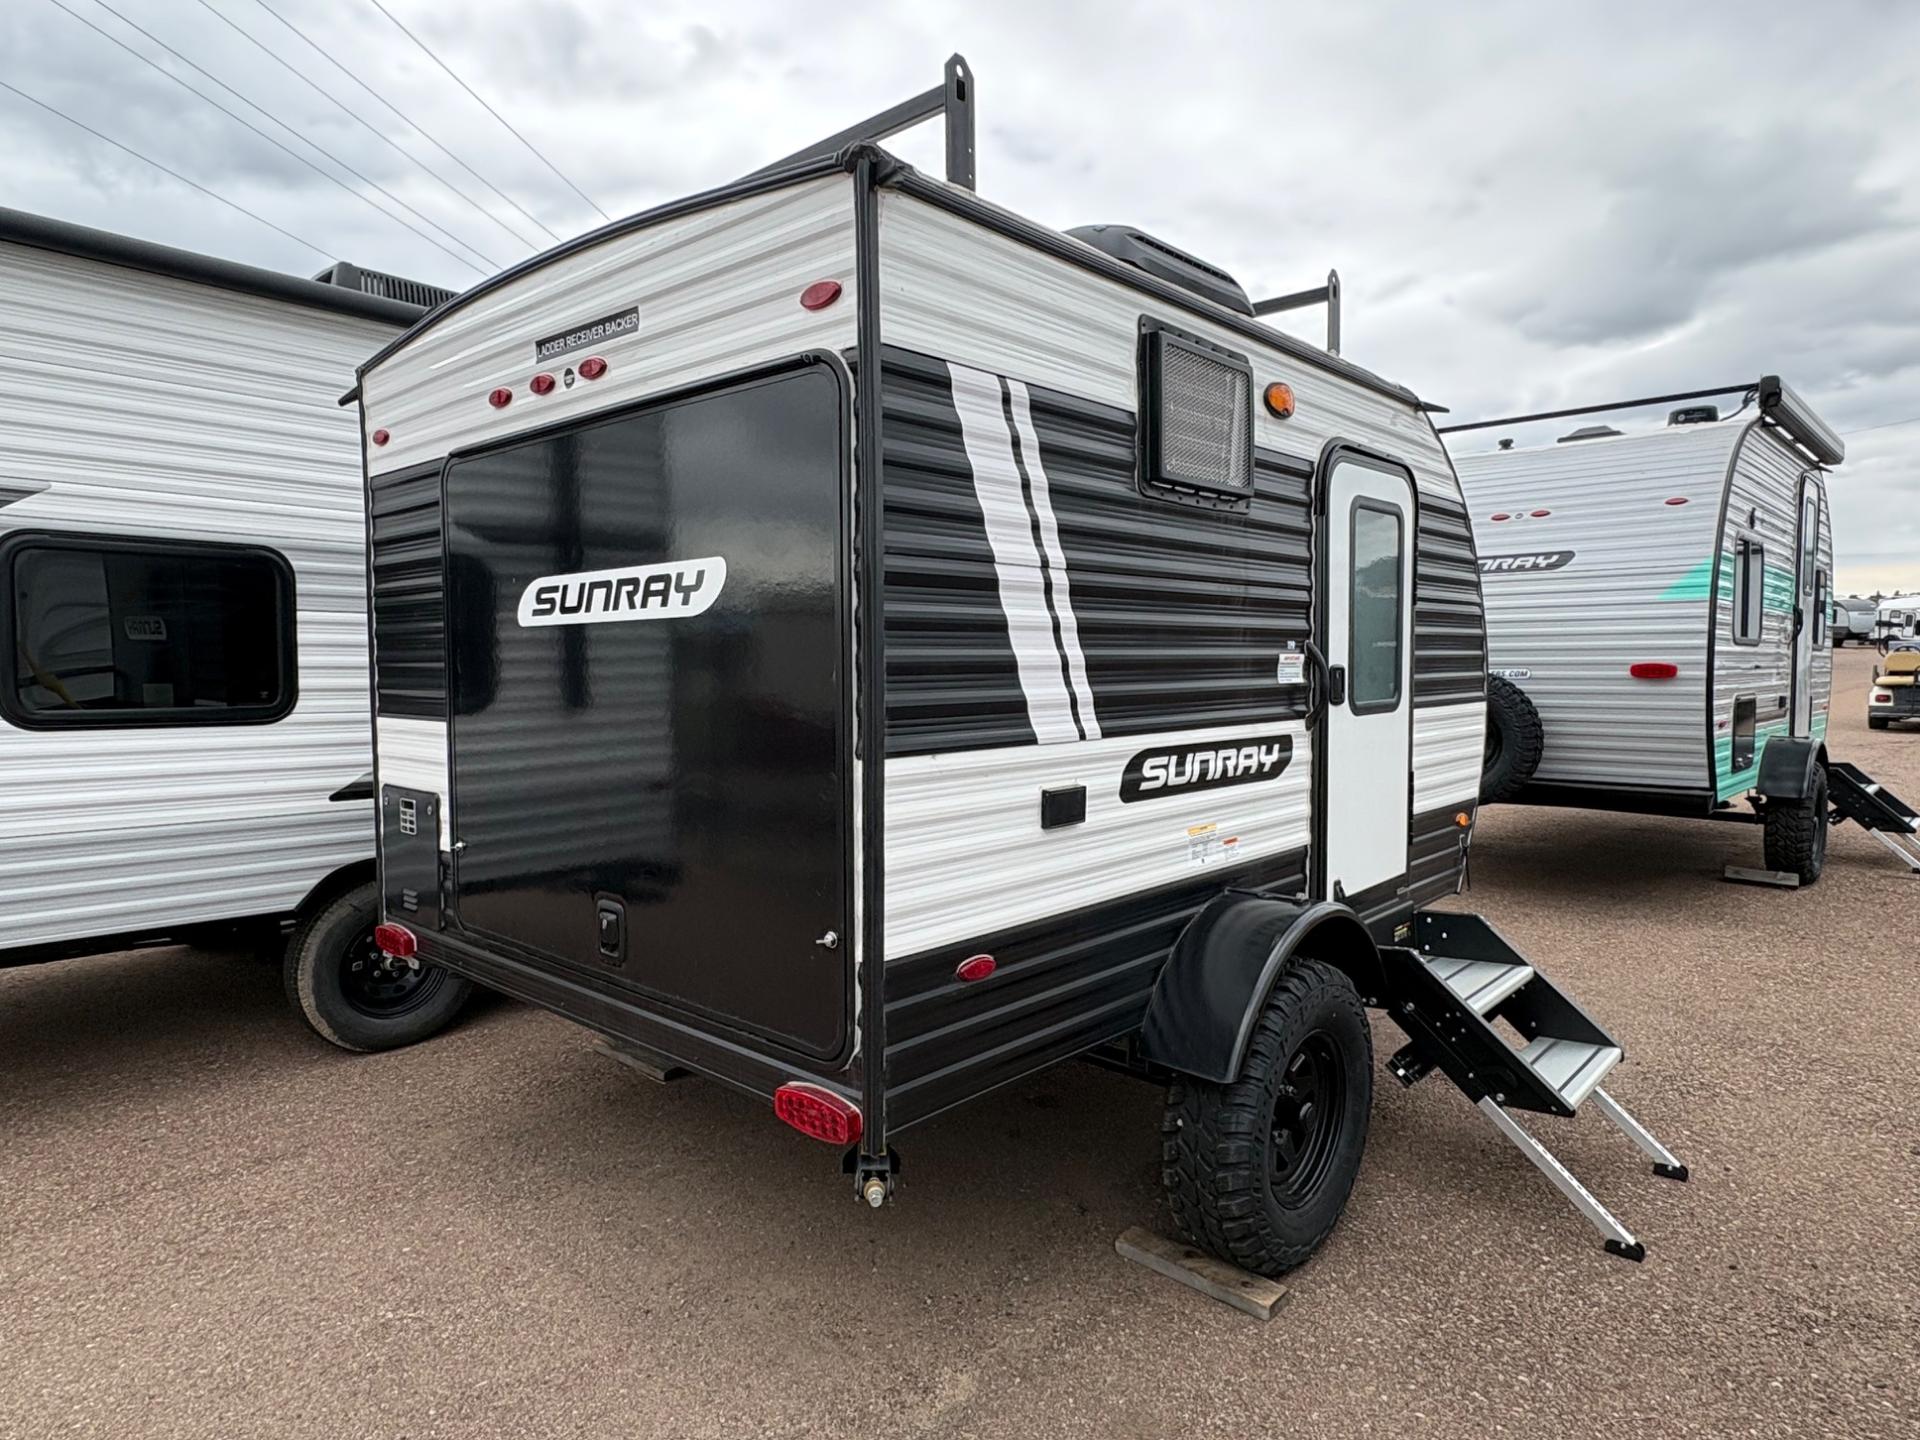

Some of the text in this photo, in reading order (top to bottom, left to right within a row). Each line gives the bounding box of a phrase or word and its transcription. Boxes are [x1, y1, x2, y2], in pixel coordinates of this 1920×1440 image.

[537, 313, 639, 358] LADDER RECEIVER BACKER
[531, 568, 706, 617] SUNRAY
[1138, 743, 1280, 791] SUNRAY
